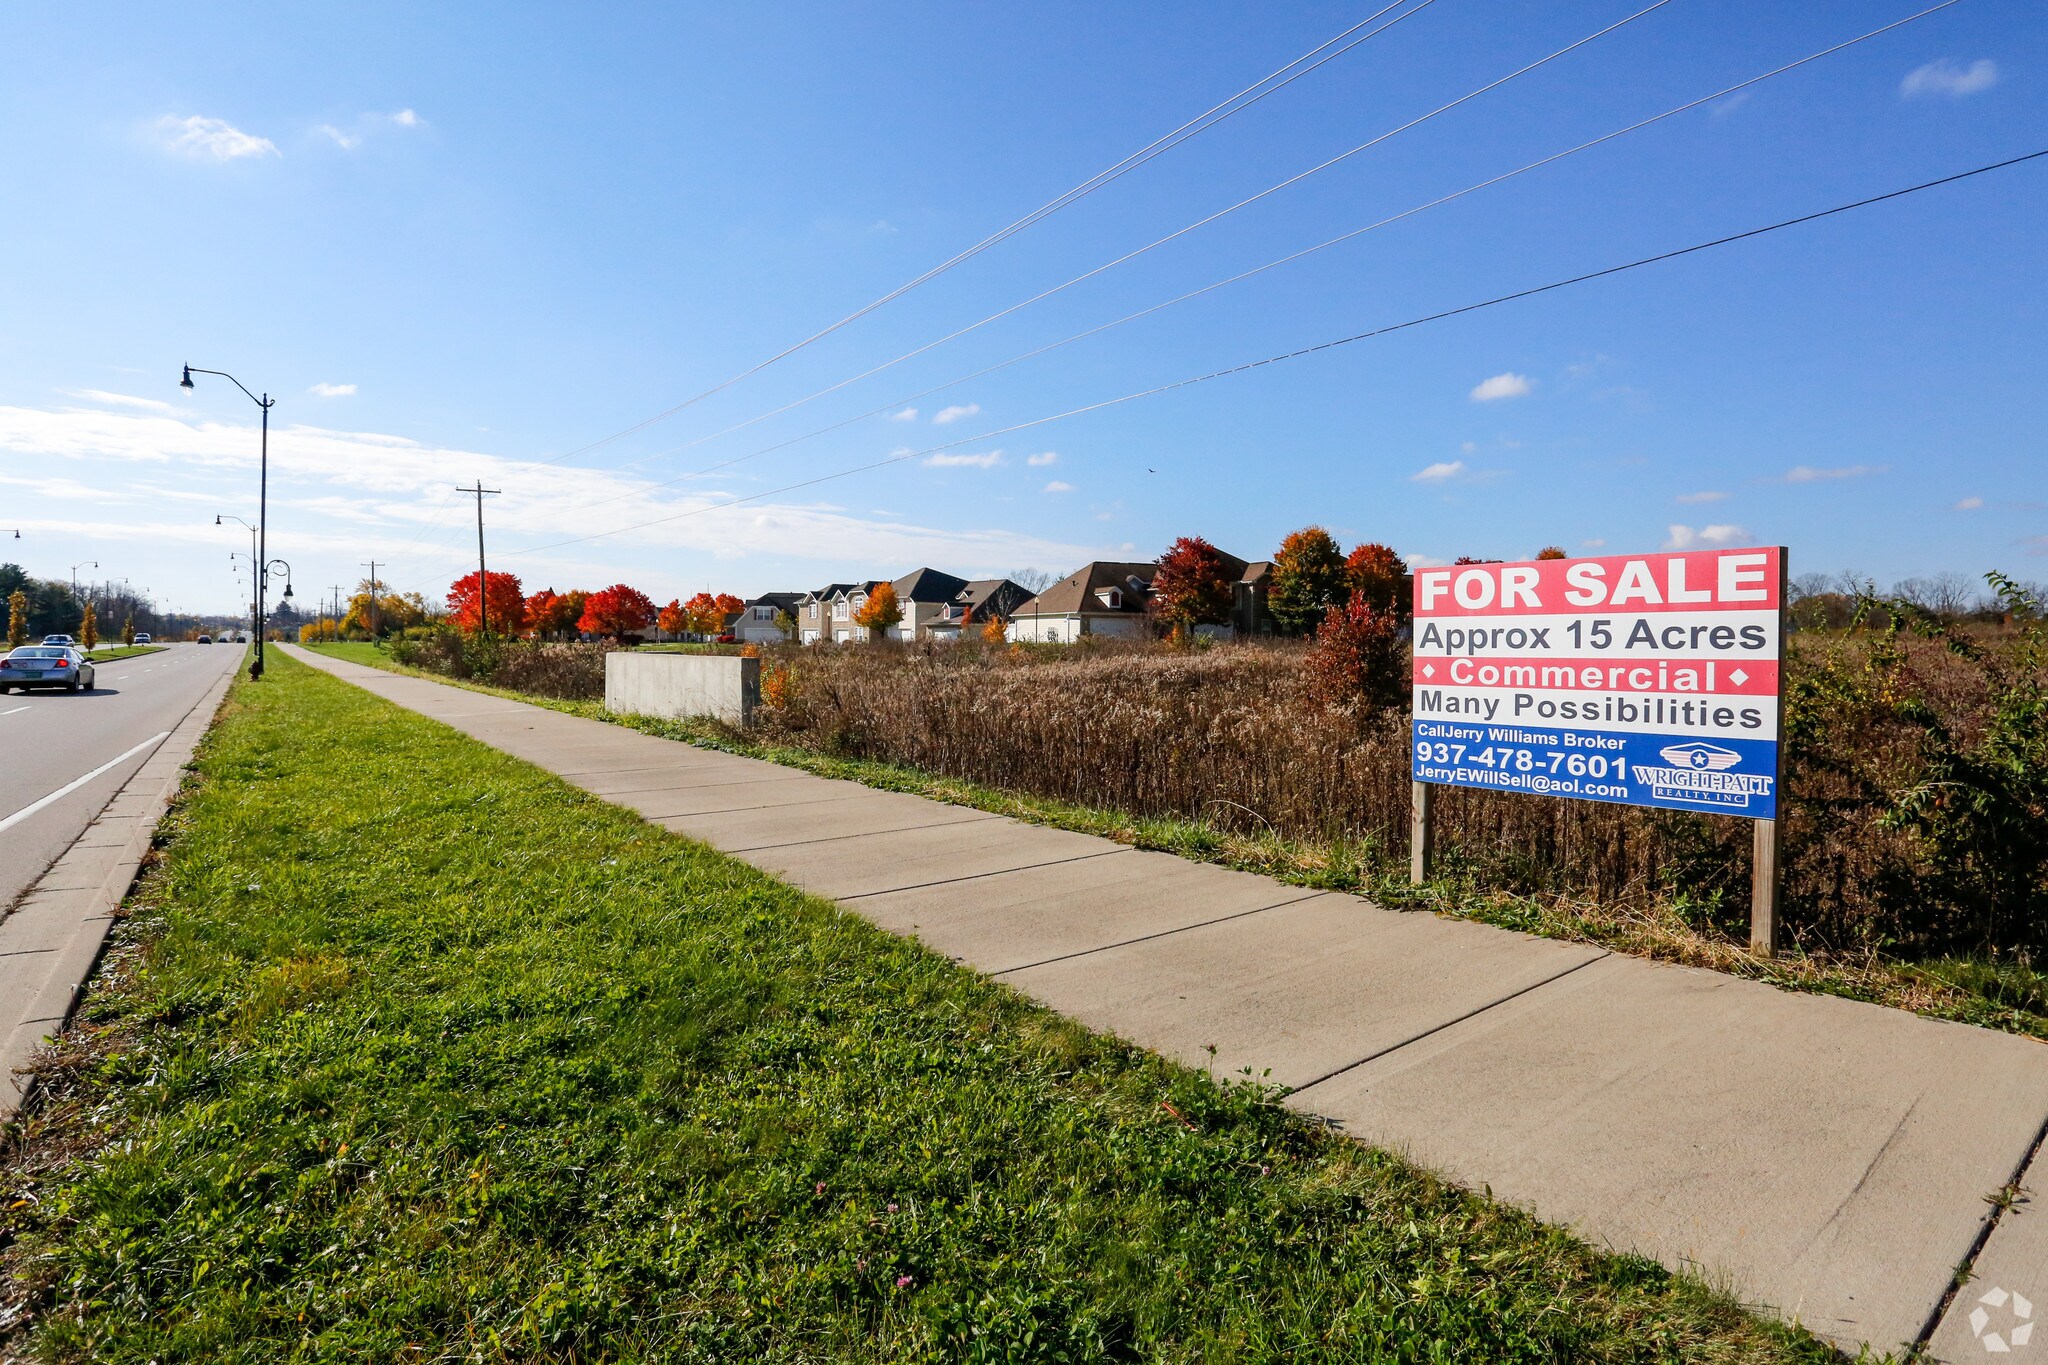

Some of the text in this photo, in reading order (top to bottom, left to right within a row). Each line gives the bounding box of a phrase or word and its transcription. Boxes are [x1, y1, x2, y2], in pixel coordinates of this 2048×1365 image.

[1421, 553, 1767, 610] FOR SALE
[1419, 618, 1766, 655] Approx 15 Acres
[1450, 658, 1715, 691] Commercial
[1421, 690, 1762, 729] Many Possibilities
[1488, 728, 1558, 745] Williams
[1564, 733, 1626, 750] Broker
[1416, 741, 1626, 780] 937-478-7601
[1416, 764, 1628, 798] JerryEWillSell@aol.com
